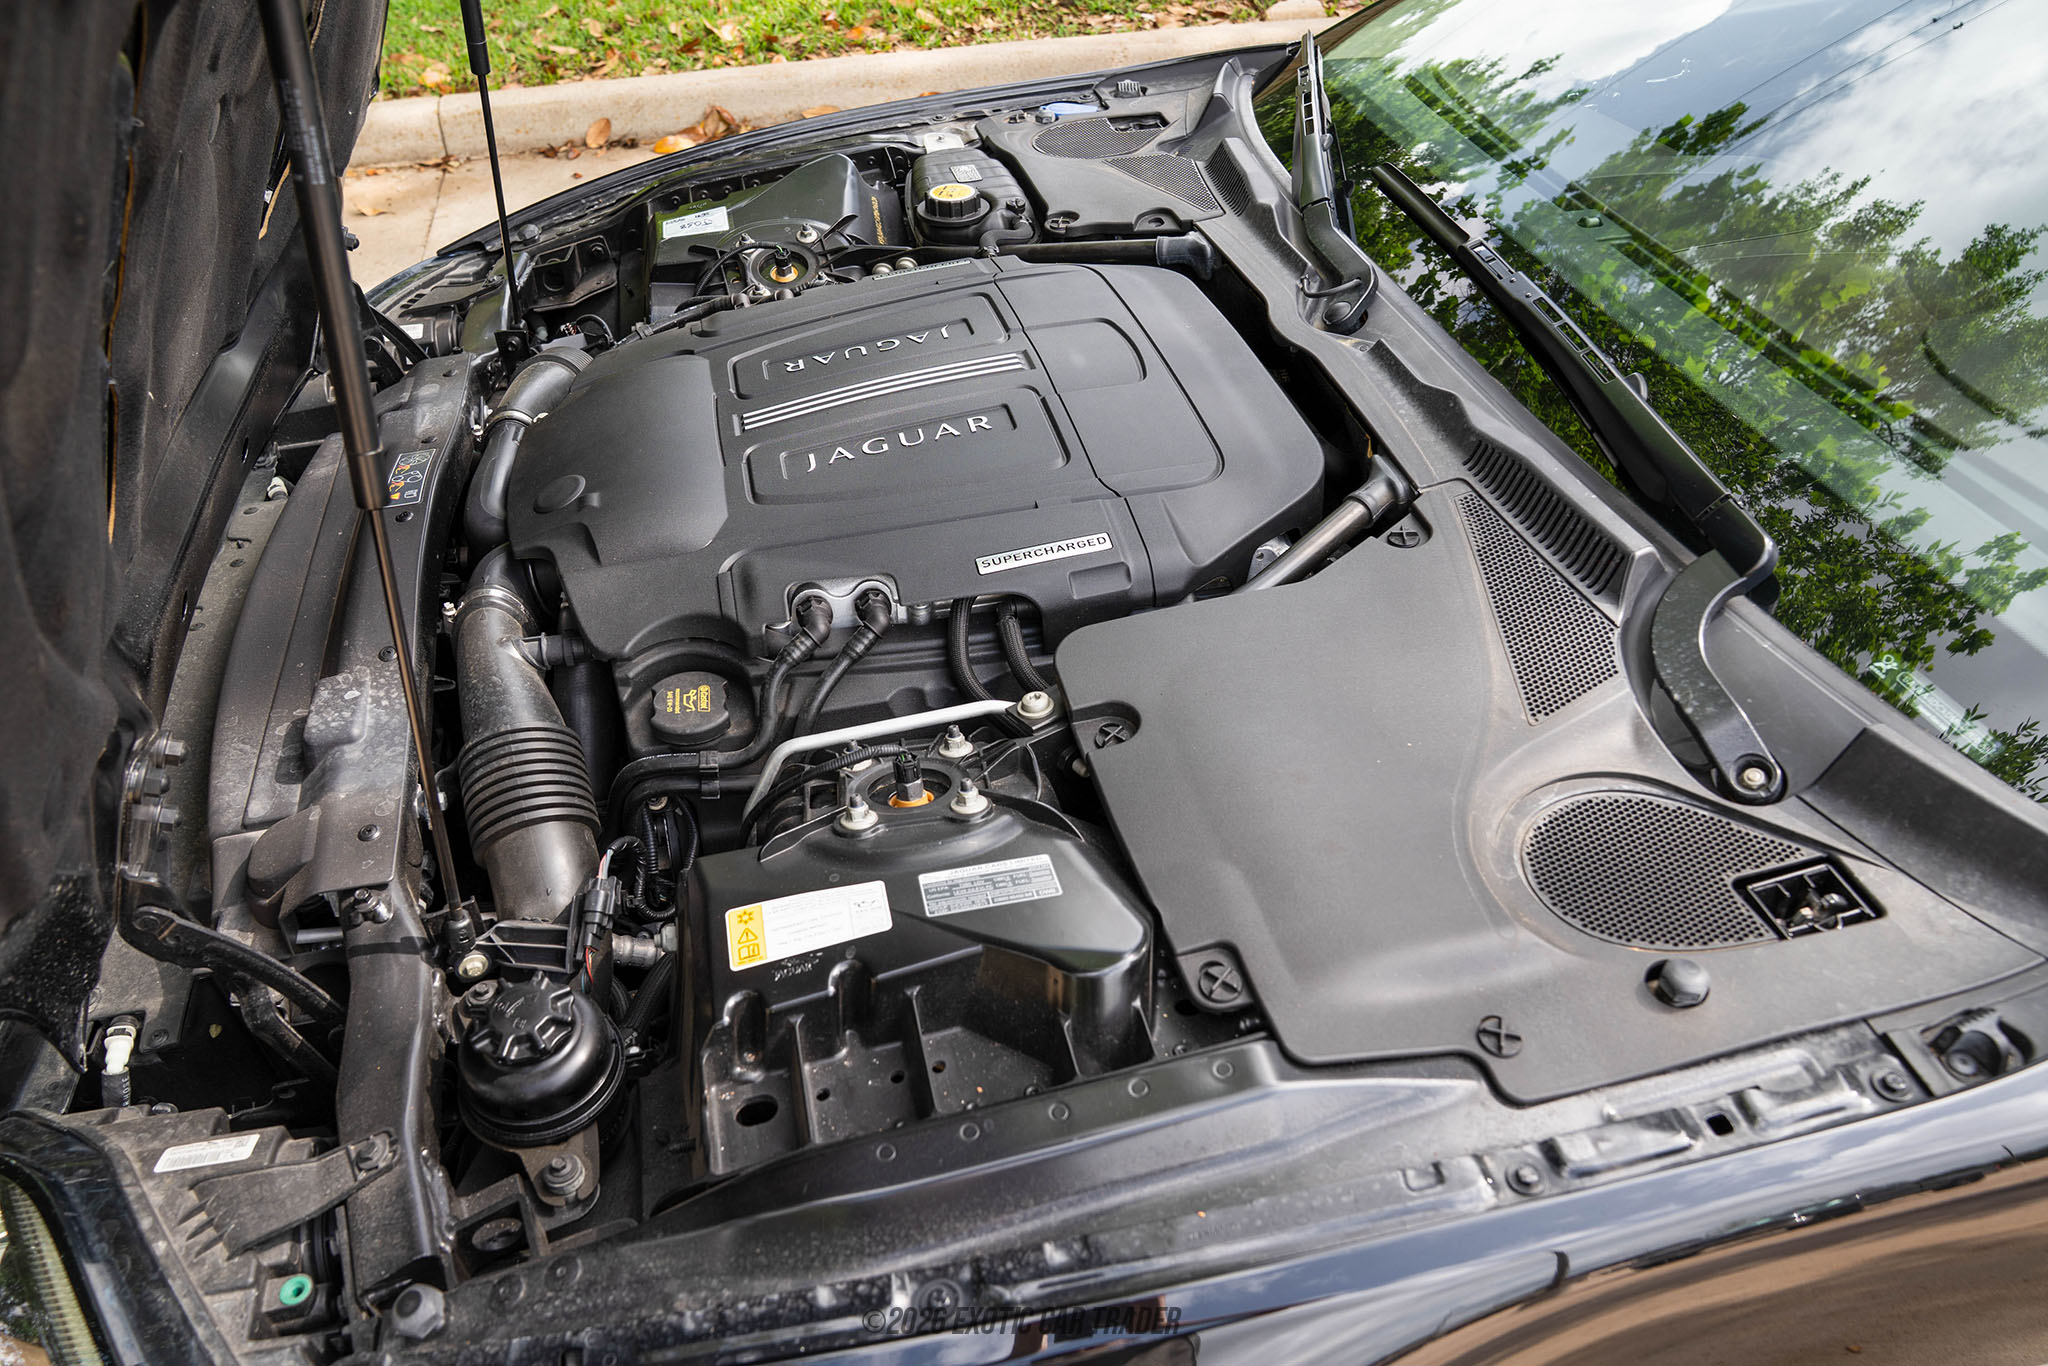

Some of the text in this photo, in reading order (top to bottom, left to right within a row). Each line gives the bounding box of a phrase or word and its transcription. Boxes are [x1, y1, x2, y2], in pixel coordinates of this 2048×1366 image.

[784, 324, 950, 372] JAGUAR
[806, 415, 993, 473] JAGUAR
[981, 536, 1107, 568] SUPERCHARGED
